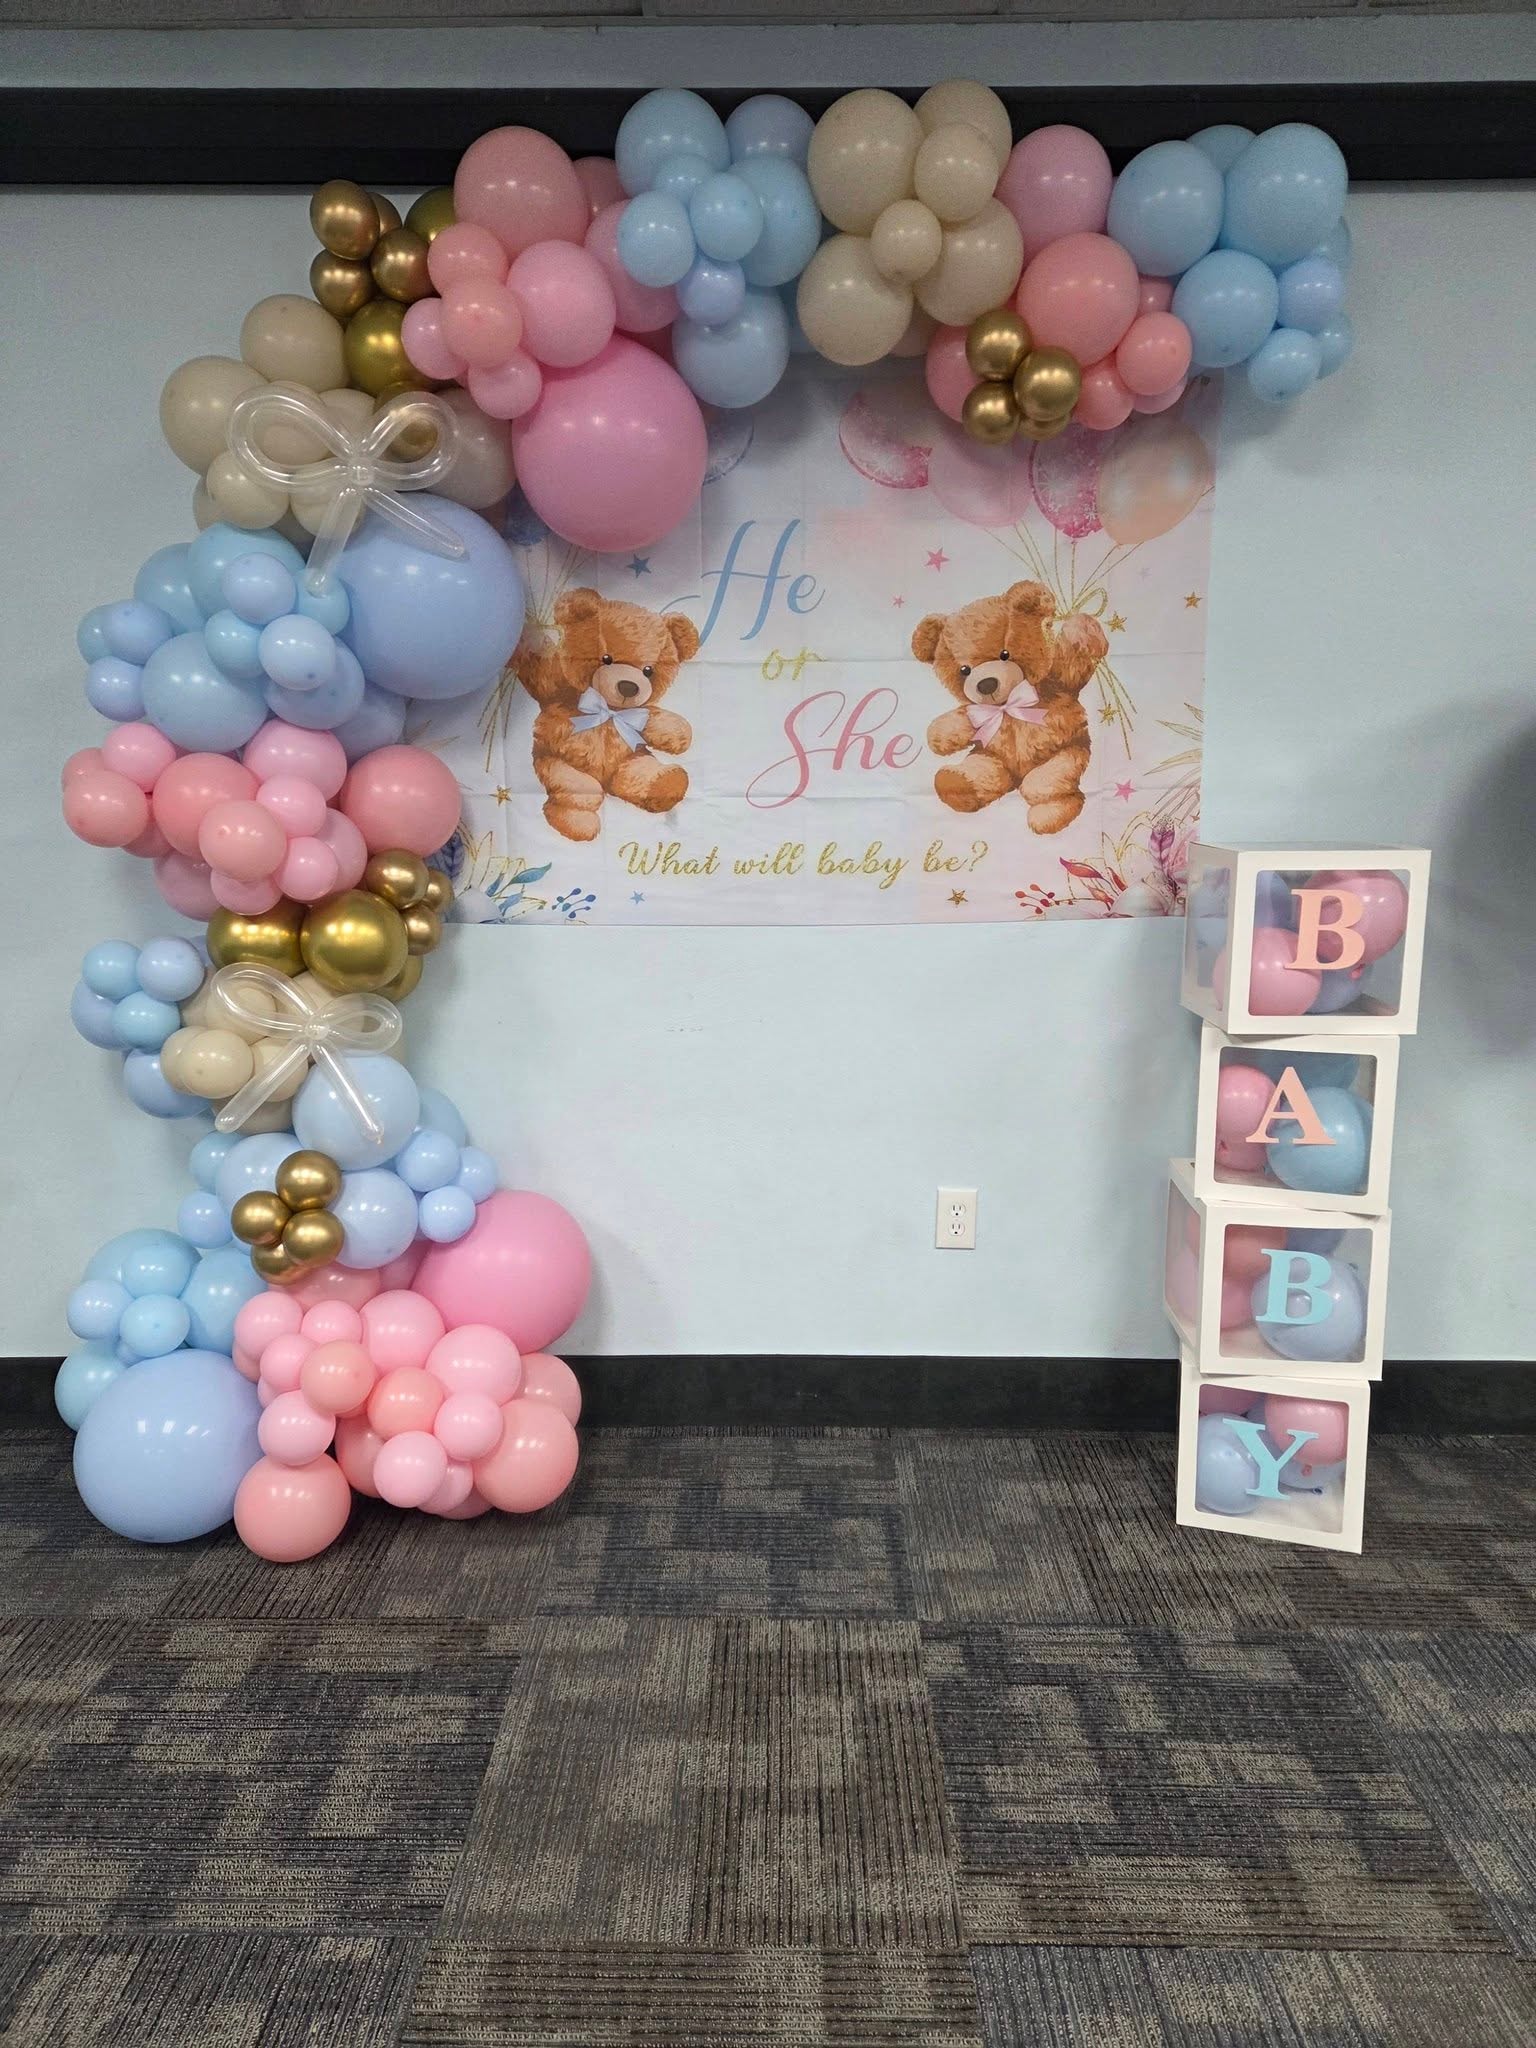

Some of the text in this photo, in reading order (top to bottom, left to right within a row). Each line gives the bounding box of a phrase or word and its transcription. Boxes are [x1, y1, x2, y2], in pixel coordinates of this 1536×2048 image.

[659, 519, 826, 647] He
[761, 647, 828, 681] or
[746, 688, 923, 809] She
[618, 840, 989, 890] What will baby be?
